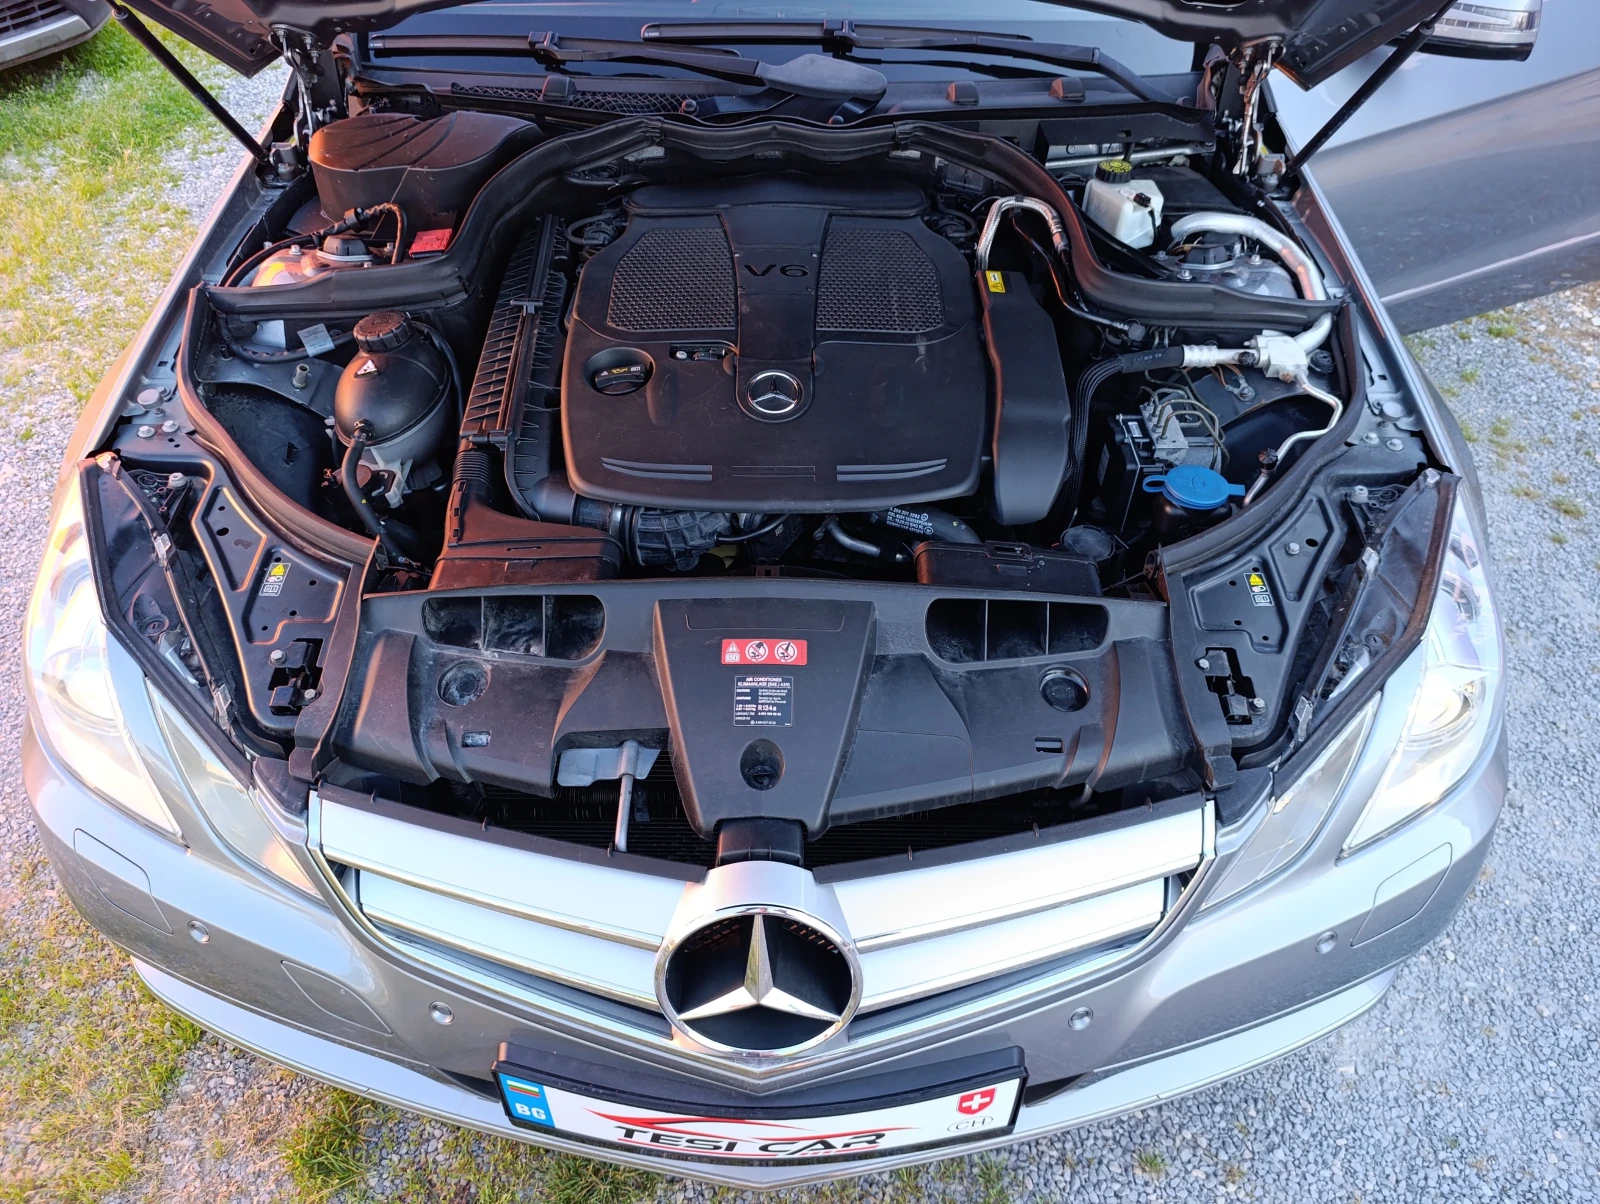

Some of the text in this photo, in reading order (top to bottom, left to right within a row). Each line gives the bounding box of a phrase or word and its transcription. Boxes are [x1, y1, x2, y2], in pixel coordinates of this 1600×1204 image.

[743, 264, 810, 278] V6
[515, 1102, 547, 1120] BG
[955, 1117, 986, 1130] CH
[614, 1126, 885, 1155] TESI CAR
